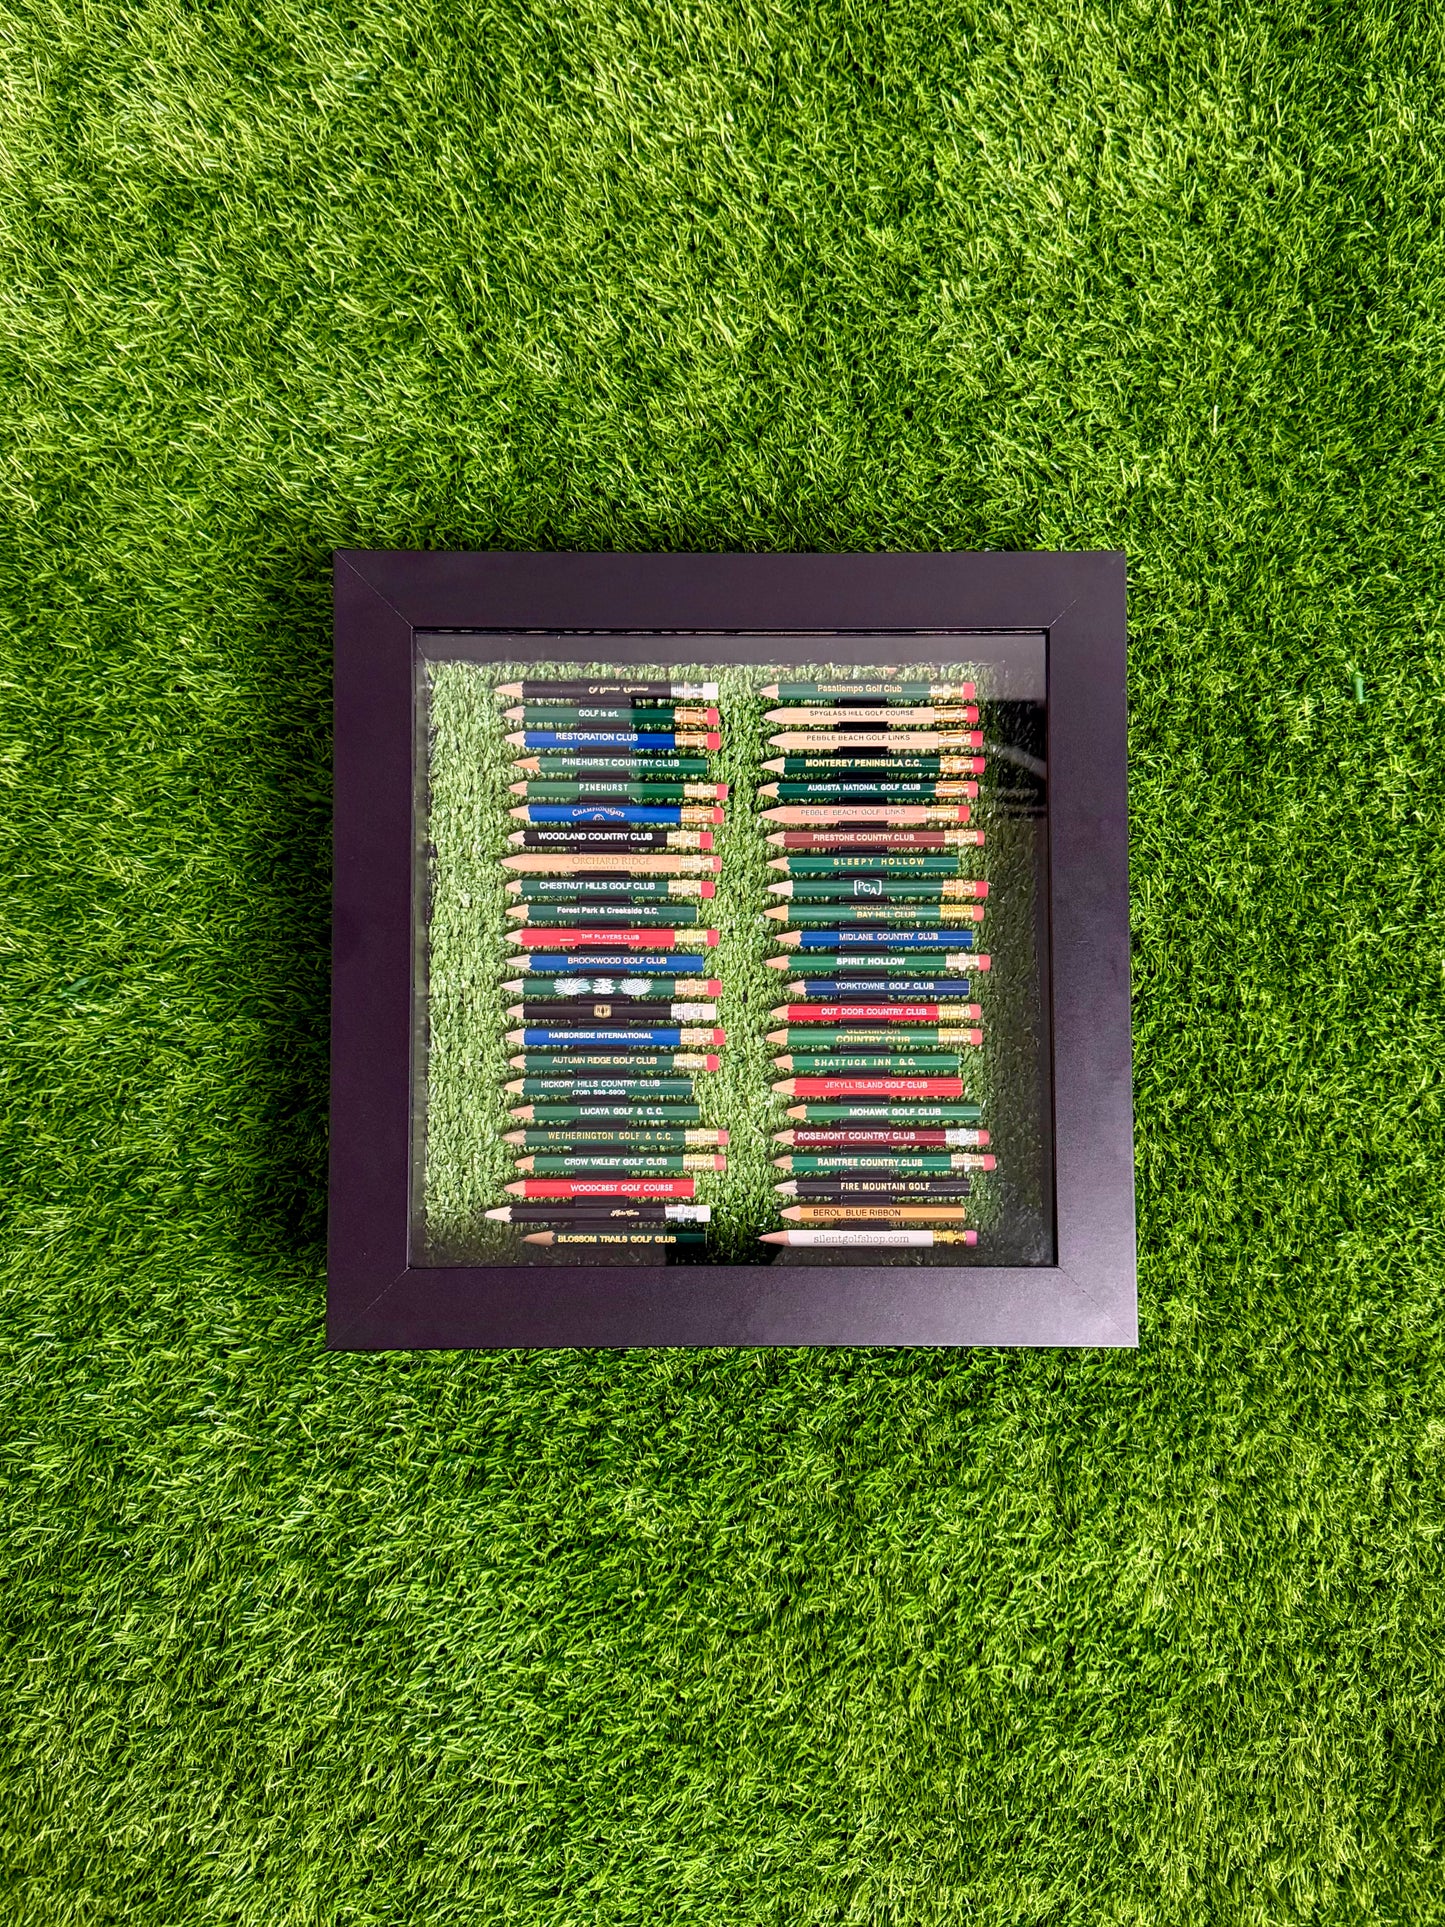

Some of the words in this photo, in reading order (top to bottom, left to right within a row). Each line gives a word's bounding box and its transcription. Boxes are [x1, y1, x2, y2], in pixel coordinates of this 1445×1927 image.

[818, 684, 863, 693] Pasatiempo
[866, 684, 882, 693] Golf
[884, 684, 901, 693] Club
[556, 733, 614, 741] RESTORATION
[617, 733, 638, 741] CLUB
[656, 759, 679, 767] CLUB
[806, 759, 852, 767] MONTEREY
[855, 759, 902, 767] PENINSULA
[538, 832, 586, 840] WOODLAND
[588, 832, 628, 840] COUNTRY
[631, 832, 652, 840] CLUB
[572, 856, 618, 865] ORCHARD
[621, 856, 651, 865] RIDGE
[540, 882, 583, 890] CHESTNUT
[586, 882, 607, 890] HILLS
[610, 882, 631, 890] GOLF
[634, 882, 655, 890] CLUB
[600, 907, 605, 915] &
[607, 907, 642, 915] Creekside
[644, 907, 659, 915] G.C.
[856, 911, 872, 919] BAY
[874, 911, 892, 919] HILL
[894, 911, 916, 919] CLUB
[836, 957, 865, 965] SPIRIT
[868, 957, 905, 965] HOLLOW
[541, 1080, 574, 1088] HICKORY
[578, 1080, 598, 1088] HILLS
[825, 1081, 853, 1089] JEKYLL
[855, 1081, 883, 1089] ISLAND
[885, 1081, 906, 1089] GOLF
[907, 1081, 928, 1089] CLUB
[548, 1132, 613, 1140] WETHERINGTON
[619, 1132, 639, 1140] GOLF
[657, 1133, 673, 1141] C.C.
[798, 1132, 846, 1140] ROSEMONT
[849, 1132, 889, 1140] COUNTRY
[892, 1132, 915, 1140] CLUB
[564, 1158, 588, 1166] CROW
[591, 1158, 620, 1166] VALLEY
[623, 1158, 643, 1166] GOLF
[647, 1158, 667, 1166] CLUB
[818, 1158, 858, 1166] RAINTREE
[860, 1158, 899, 1166] COUNTRY
[901, 1158, 922, 1166] CLUB
[571, 1184, 617, 1192] WOODCREST
[621, 1184, 640, 1192] GOLF
[644, 1184, 673, 1192] COURSE
[814, 1234, 909, 1245] silentgolfshop.com
